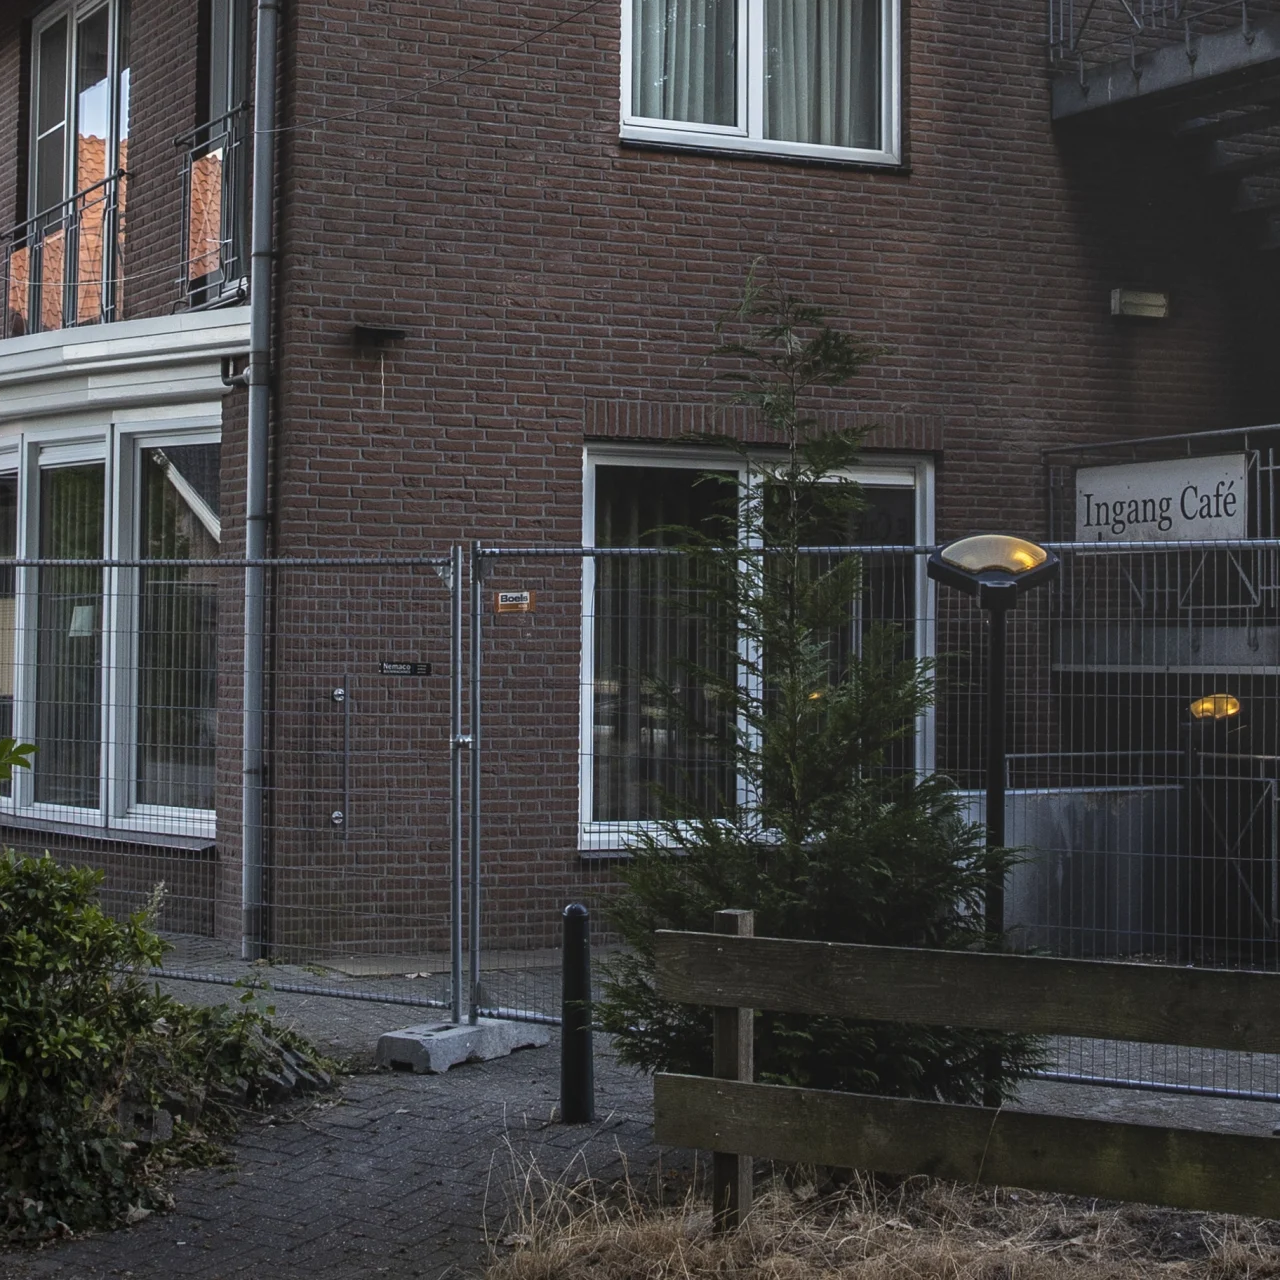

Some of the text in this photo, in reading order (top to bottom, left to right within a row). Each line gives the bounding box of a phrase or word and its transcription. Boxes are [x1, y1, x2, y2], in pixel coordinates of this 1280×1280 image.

[1083, 480, 1237, 535] Ingang Café
[500, 594, 528, 603] Boels
[383, 662, 411, 670] Nemaco
